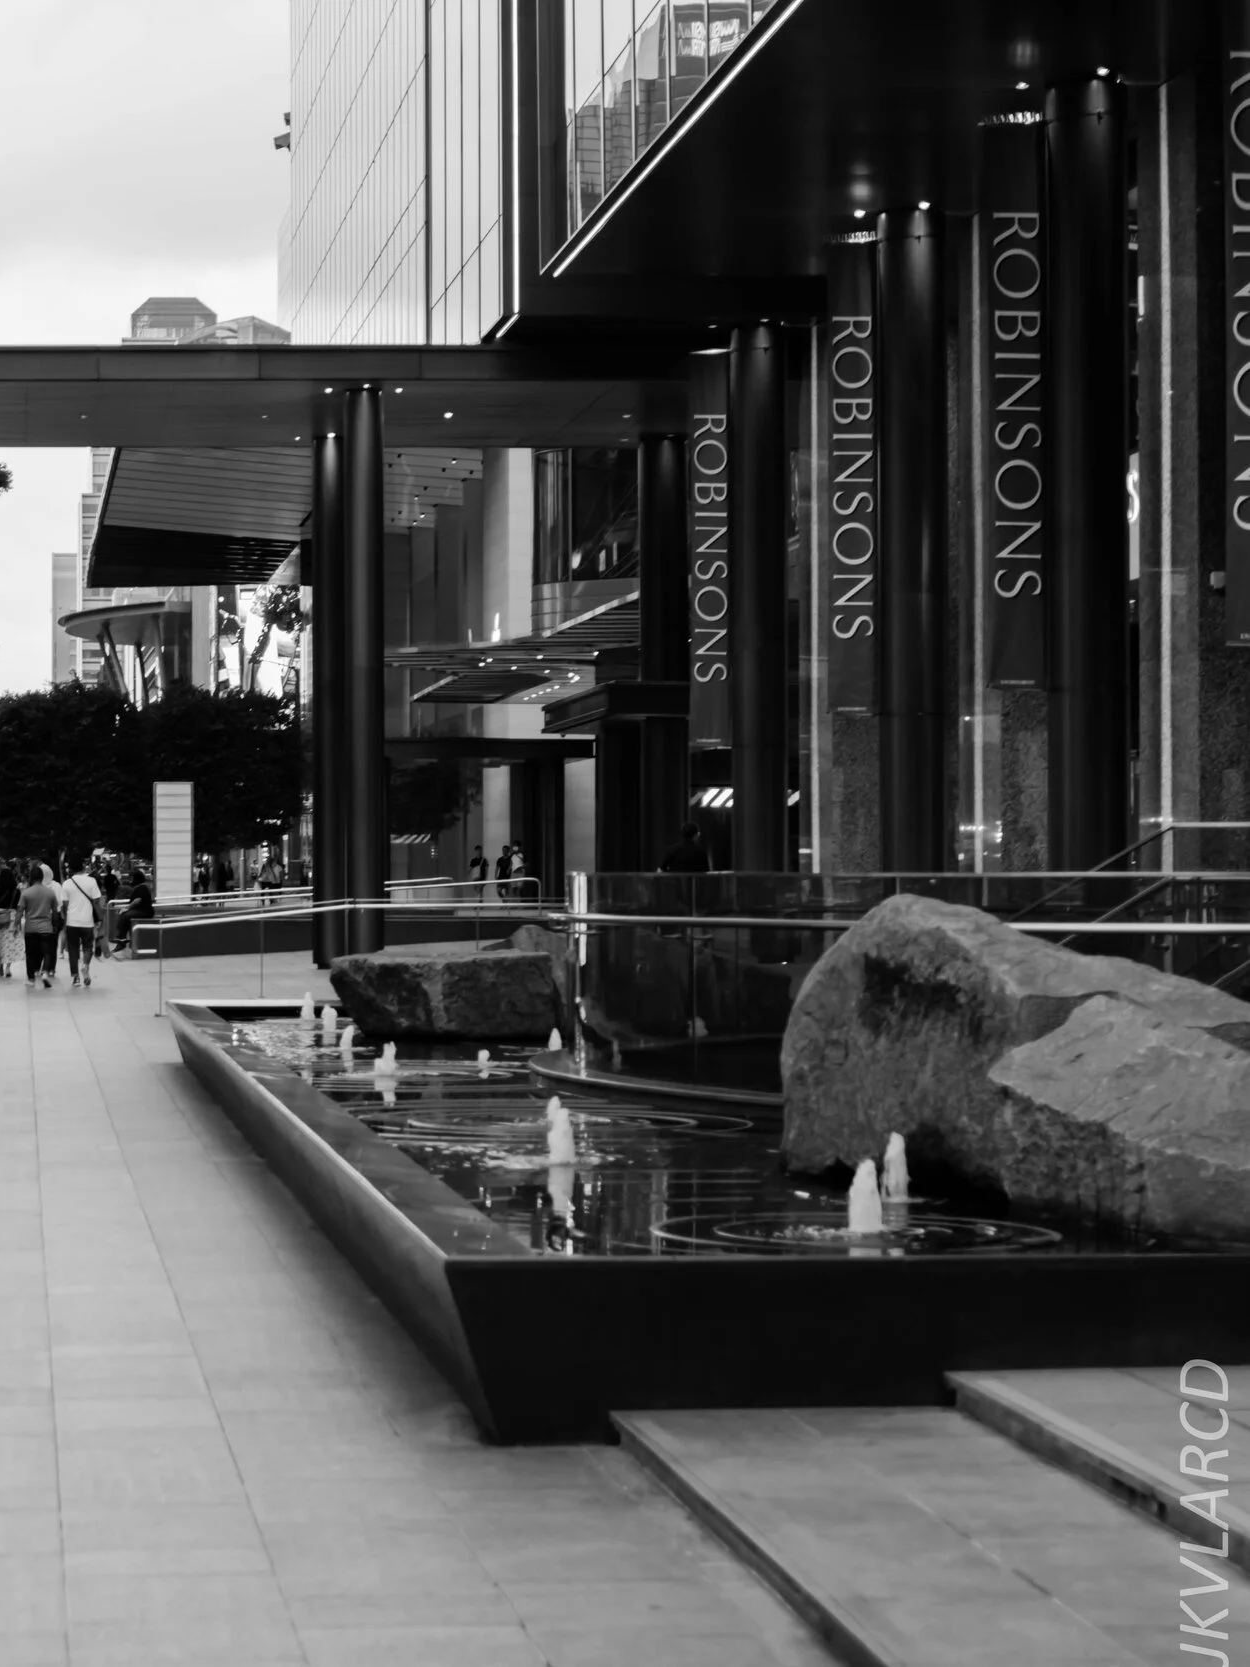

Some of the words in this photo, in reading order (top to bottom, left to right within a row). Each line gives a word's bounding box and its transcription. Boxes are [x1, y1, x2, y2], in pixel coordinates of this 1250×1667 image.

[693, 413, 728, 685] ROBINSONS
[831, 315, 874, 640] ROBINSONS
[993, 211, 1042, 598] ROBINSONS
